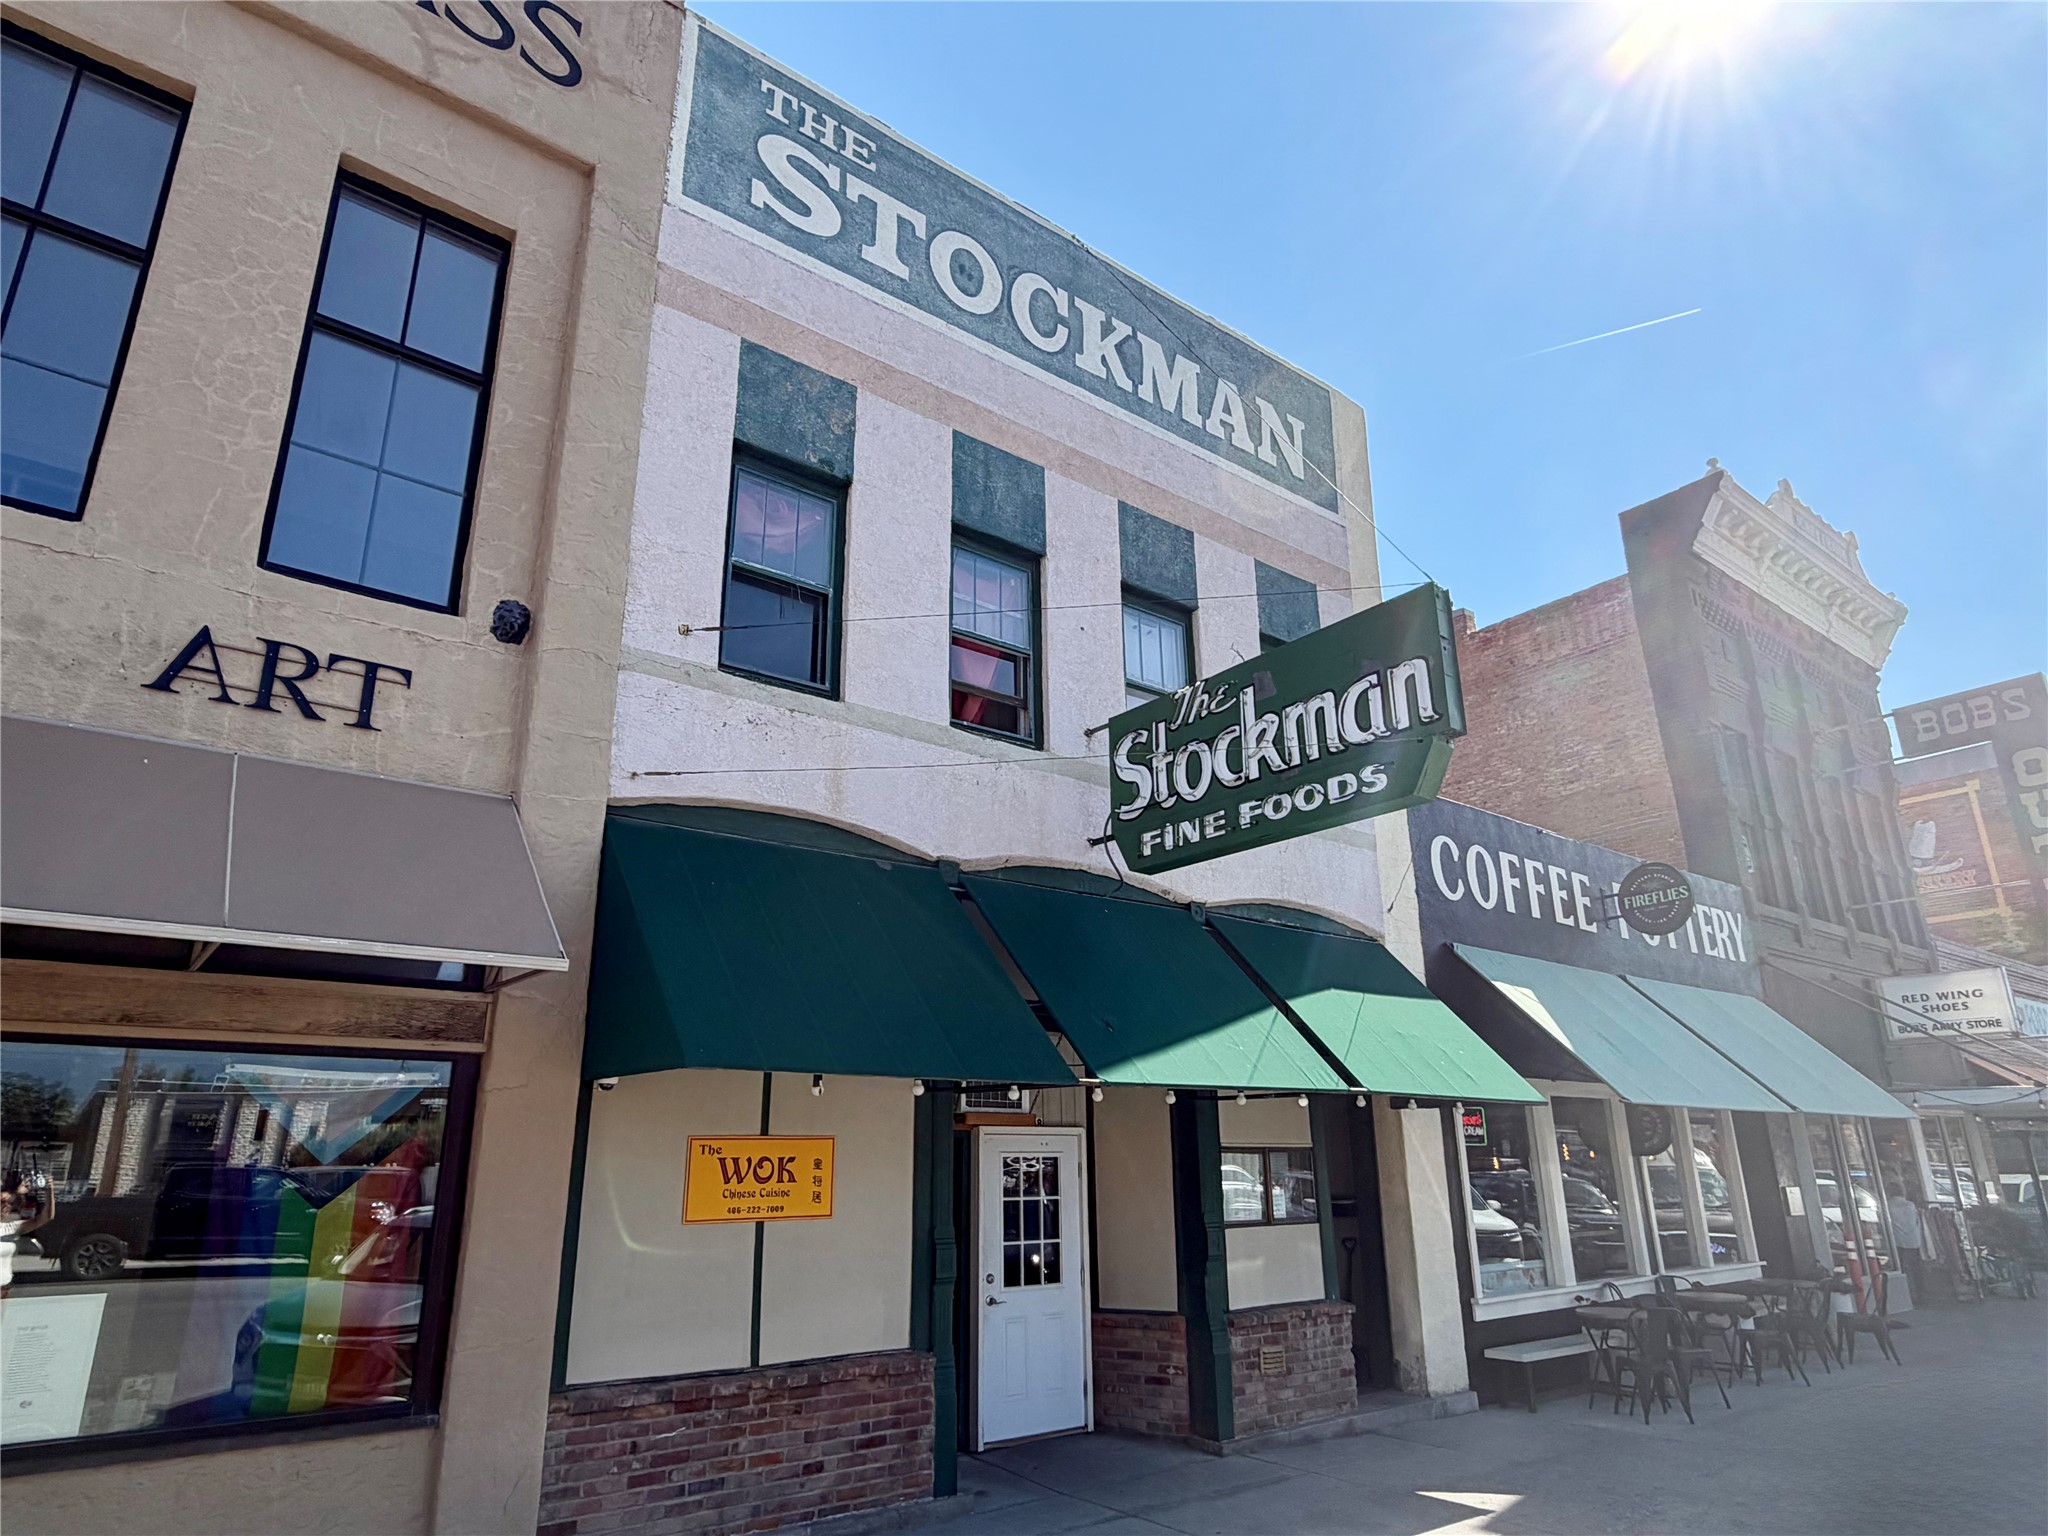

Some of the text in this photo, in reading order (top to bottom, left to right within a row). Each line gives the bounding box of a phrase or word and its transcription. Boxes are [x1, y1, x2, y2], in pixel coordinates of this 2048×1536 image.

[416, 0, 583, 88] SS
[760, 79, 878, 172] THE
[750, 133, 1306, 482] STOCKMAN
[141, 625, 412, 731] ART
[1171, 682, 1238, 727] The
[1911, 687, 2031, 743] BOB'S
[1114, 657, 1441, 821] Stockman
[1139, 763, 1390, 857] FINE FOODS
[1430, 834, 1598, 933] COFFEE
[1623, 885, 1689, 909] FIREFLIES
[1901, 988, 1984, 1004] RED WING
[1921, 1001, 1969, 1014] SHOES
[1966, 1018, 2002, 1029] STORE
[699, 1144, 723, 1156] The
[717, 1155, 797, 1185] WOK
[722, 1187, 791, 1200] Chinese Cuisine
[726, 1205, 785, 1214] 406-222-7009
